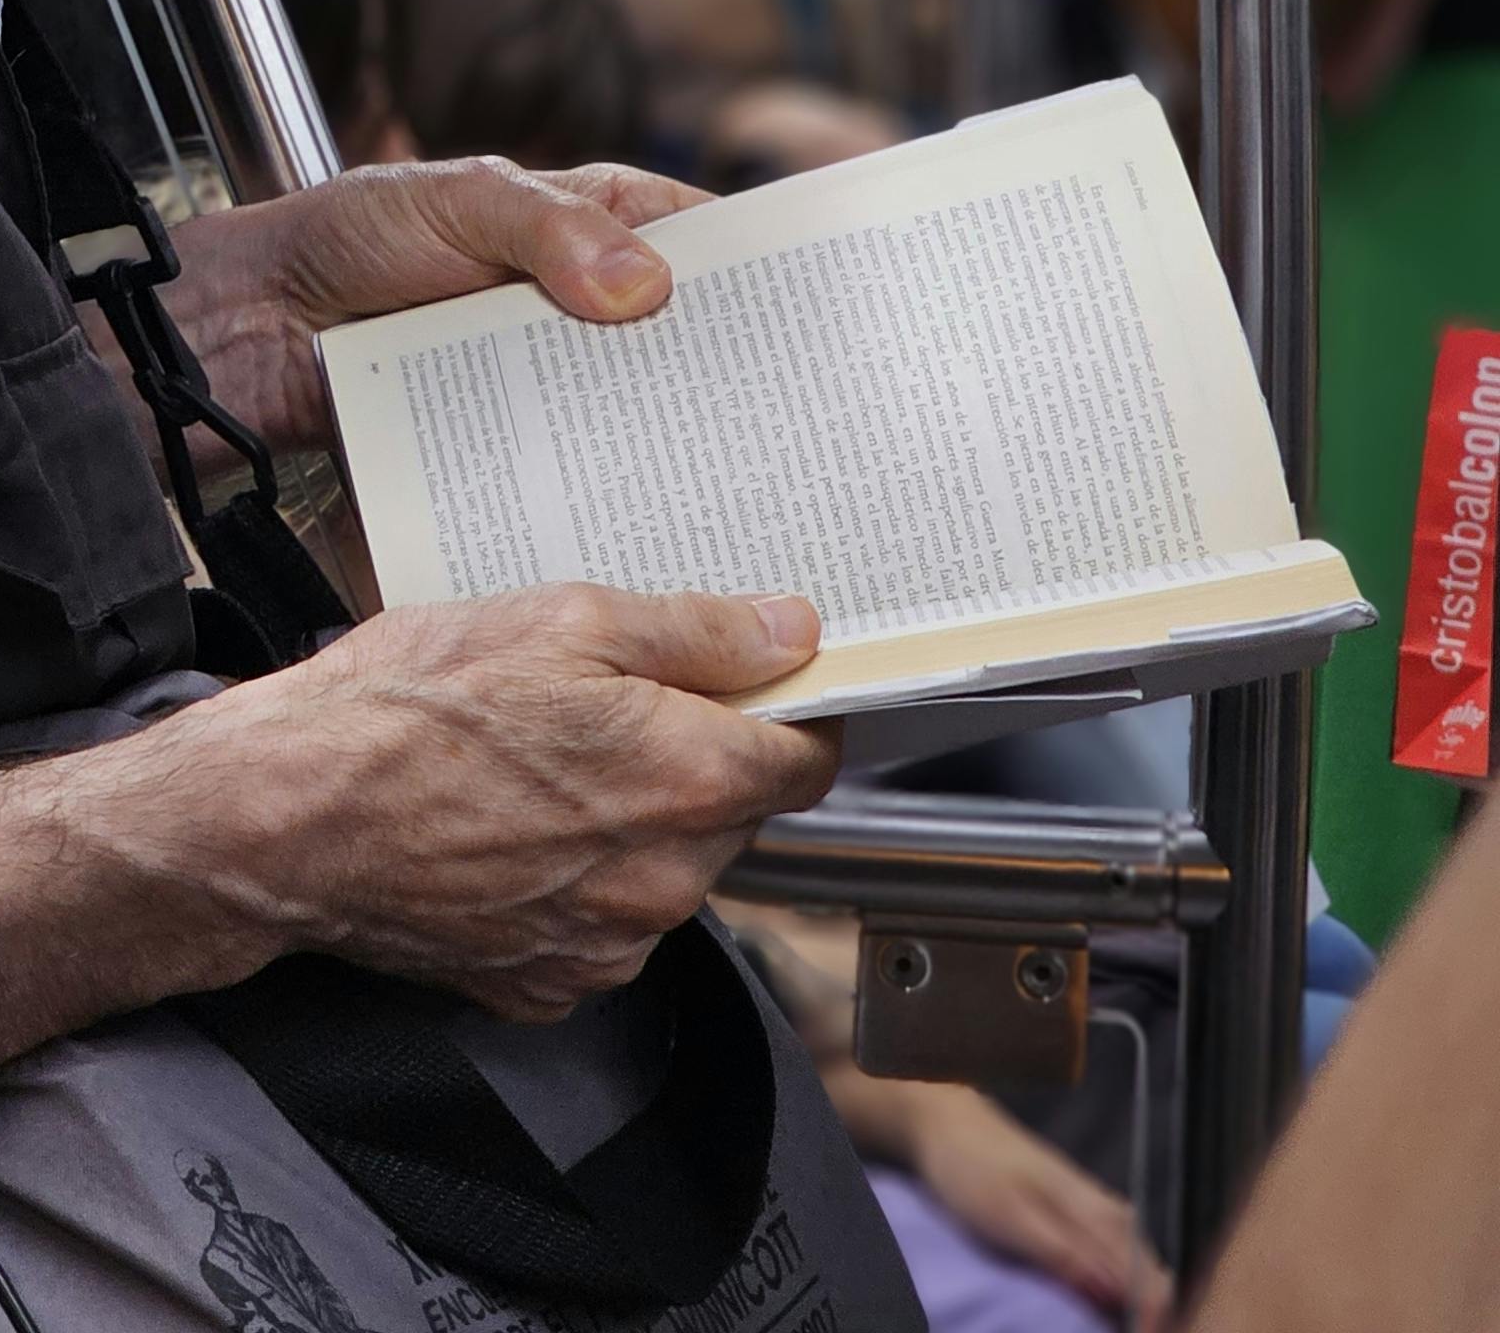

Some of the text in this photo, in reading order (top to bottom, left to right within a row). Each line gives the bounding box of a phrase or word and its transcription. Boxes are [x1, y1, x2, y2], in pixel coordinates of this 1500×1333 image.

[938, 357, 953, 377] los
[944, 379, 960, 408] años
[1017, 371, 1032, 391] los
[1127, 361, 1148, 409] abiertos
[1133, 319, 1157, 373] recolocar
[1150, 390, 1179, 450] problema
[728, 415, 746, 441] para
[986, 391, 1010, 449] dirección
[1023, 392, 1047, 446] intereses
[1044, 335, 1059, 354] los
[1078, 454, 1092, 473] ser
[1085, 476, 1112, 542] restaurada
[1071, 361, 1085, 380] sea
[1108, 494, 1123, 520] una
[1089, 359, 1115, 420] identificar
[1112, 440, 1133, 484] Estado
[1125, 487, 1139, 512] con
[1119, 397, 1134, 423] una
[1127, 425, 1155, 501] redefinición
[1137, 412, 1156, 434] por
[593, 455, 612, 485] 1933
[644, 437, 666, 491] empresas
[708, 399, 753, 538] hidrocarburos, habilitar
[737, 443, 753, 468] que
[796, 384, 828, 472] independientes
[817, 475, 843, 530] perciben
[830, 437, 848, 477] ambas
[850, 375, 872, 429] inscriben
[876, 468, 901, 535] búsquedas
[890, 537, 907, 563] que
[900, 563, 914, 585] los
[963, 446, 985, 496] Primera
[1007, 468, 1022, 490] los
[1032, 359, 1051, 378] rol
[1059, 449, 1076, 484] entre
[1075, 511, 1092, 554] clases,
[1036, 449, 1064, 508] generales
[441, 486, 468, 557] planificadoras
[569, 436, 602, 539] macroeconómico,
[596, 541, 610, 567] una
[599, 487, 619, 527] fijaría,
[603, 438, 623, 472] parte,
[616, 474, 637, 517] Pinedo
[632, 535, 649, 573] frente
[625, 431, 669, 574] desocupación aliviar
[681, 436, 706, 501] Elevadores
[700, 524, 722, 567] granos
[699, 446, 716, 470] que
[709, 474, 742, 570] monopolizaban
[747, 412, 771, 468] siguiente,
[764, 470, 788, 526] desplegó
[779, 528, 804, 592] iniciativas
[750, 486, 771, 530] Estado
[776, 444, 796, 496] Tomaso,
[800, 540, 818, 576] fugaz
[790, 429, 815, 479] mundial
[806, 492, 827, 538] operan
[819, 540, 833, 561] sin
[838, 481, 864, 539] gestiones
[841, 411, 870, 479] explorando
[883, 571, 898, 594] Sin
[872, 402, 899, 456] posterior
[897, 477, 919, 532] Federico
[911, 534, 933, 579] Pinedo
[909, 469, 933, 513] primer
[925, 517, 945, 564] intento
[913, 402, 938, 461] funciones
[931, 464, 963, 555] desempeñadas
[950, 558, 969, 581] por
[939, 429, 959, 472] interés
[951, 474, 979, 549] significativo
[978, 499, 997, 545] Guerra
[1012, 432, 1035, 474] piensa
[1039, 518, 1060, 562] Estado
[1013, 491, 1034, 536] niveles
[1153, 453, 1181, 533] revisionismo
[503, 533, 521, 559] pour
[568, 502, 591, 563] instituiría
[682, 511, 705, 568] enfrentar
[758, 533, 782, 584] pudiera
[858, 542, 875, 569] vale
